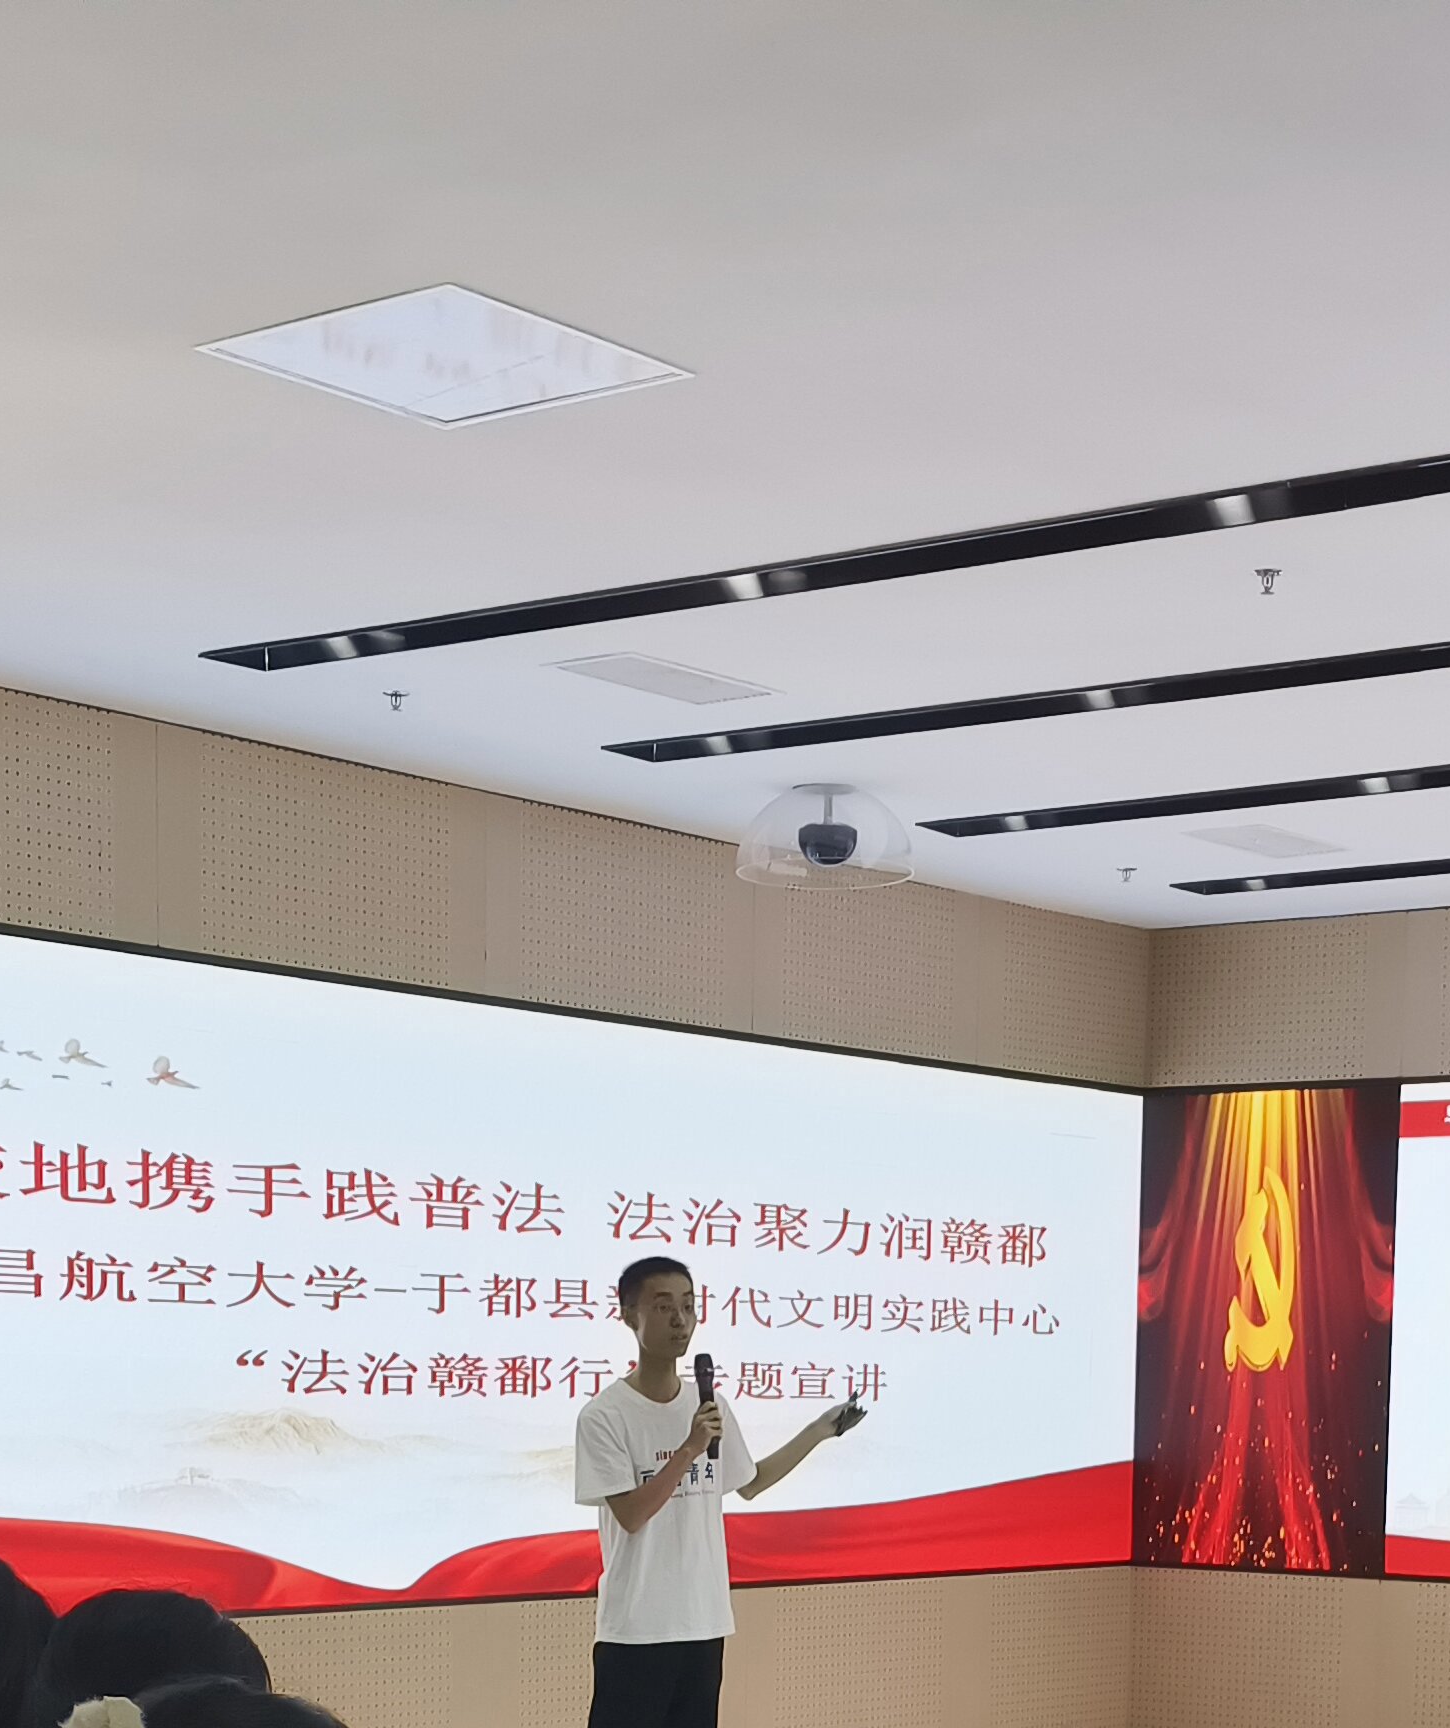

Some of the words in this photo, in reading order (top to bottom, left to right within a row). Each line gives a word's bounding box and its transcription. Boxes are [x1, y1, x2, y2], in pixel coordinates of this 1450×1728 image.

[607, 1191, 1048, 1269] 法治聚力润赣鄱
